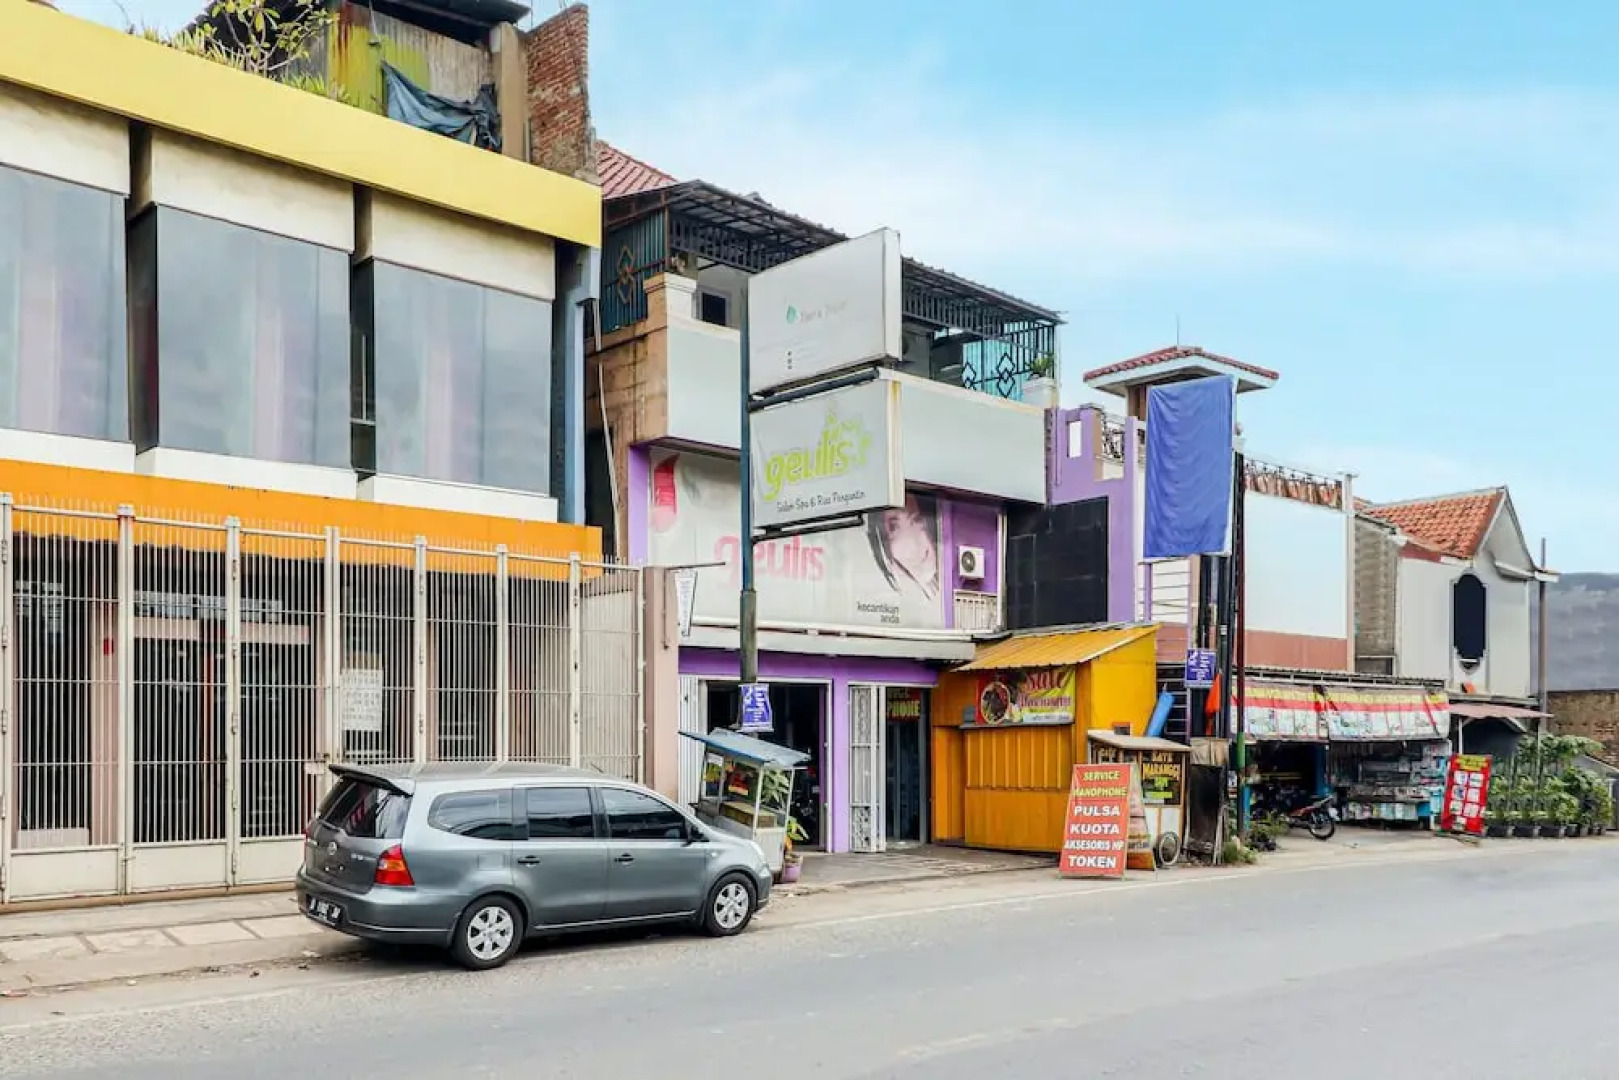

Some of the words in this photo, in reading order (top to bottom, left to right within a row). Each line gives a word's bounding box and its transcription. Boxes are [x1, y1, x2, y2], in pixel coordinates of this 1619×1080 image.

[764, 428, 853, 502] geulis
[1083, 771, 1120, 781] SERVICE
[1074, 805, 1120, 817] PULSA
[1070, 824, 1120, 835] KUOTA
[1068, 855, 1117, 868] TOKEN
